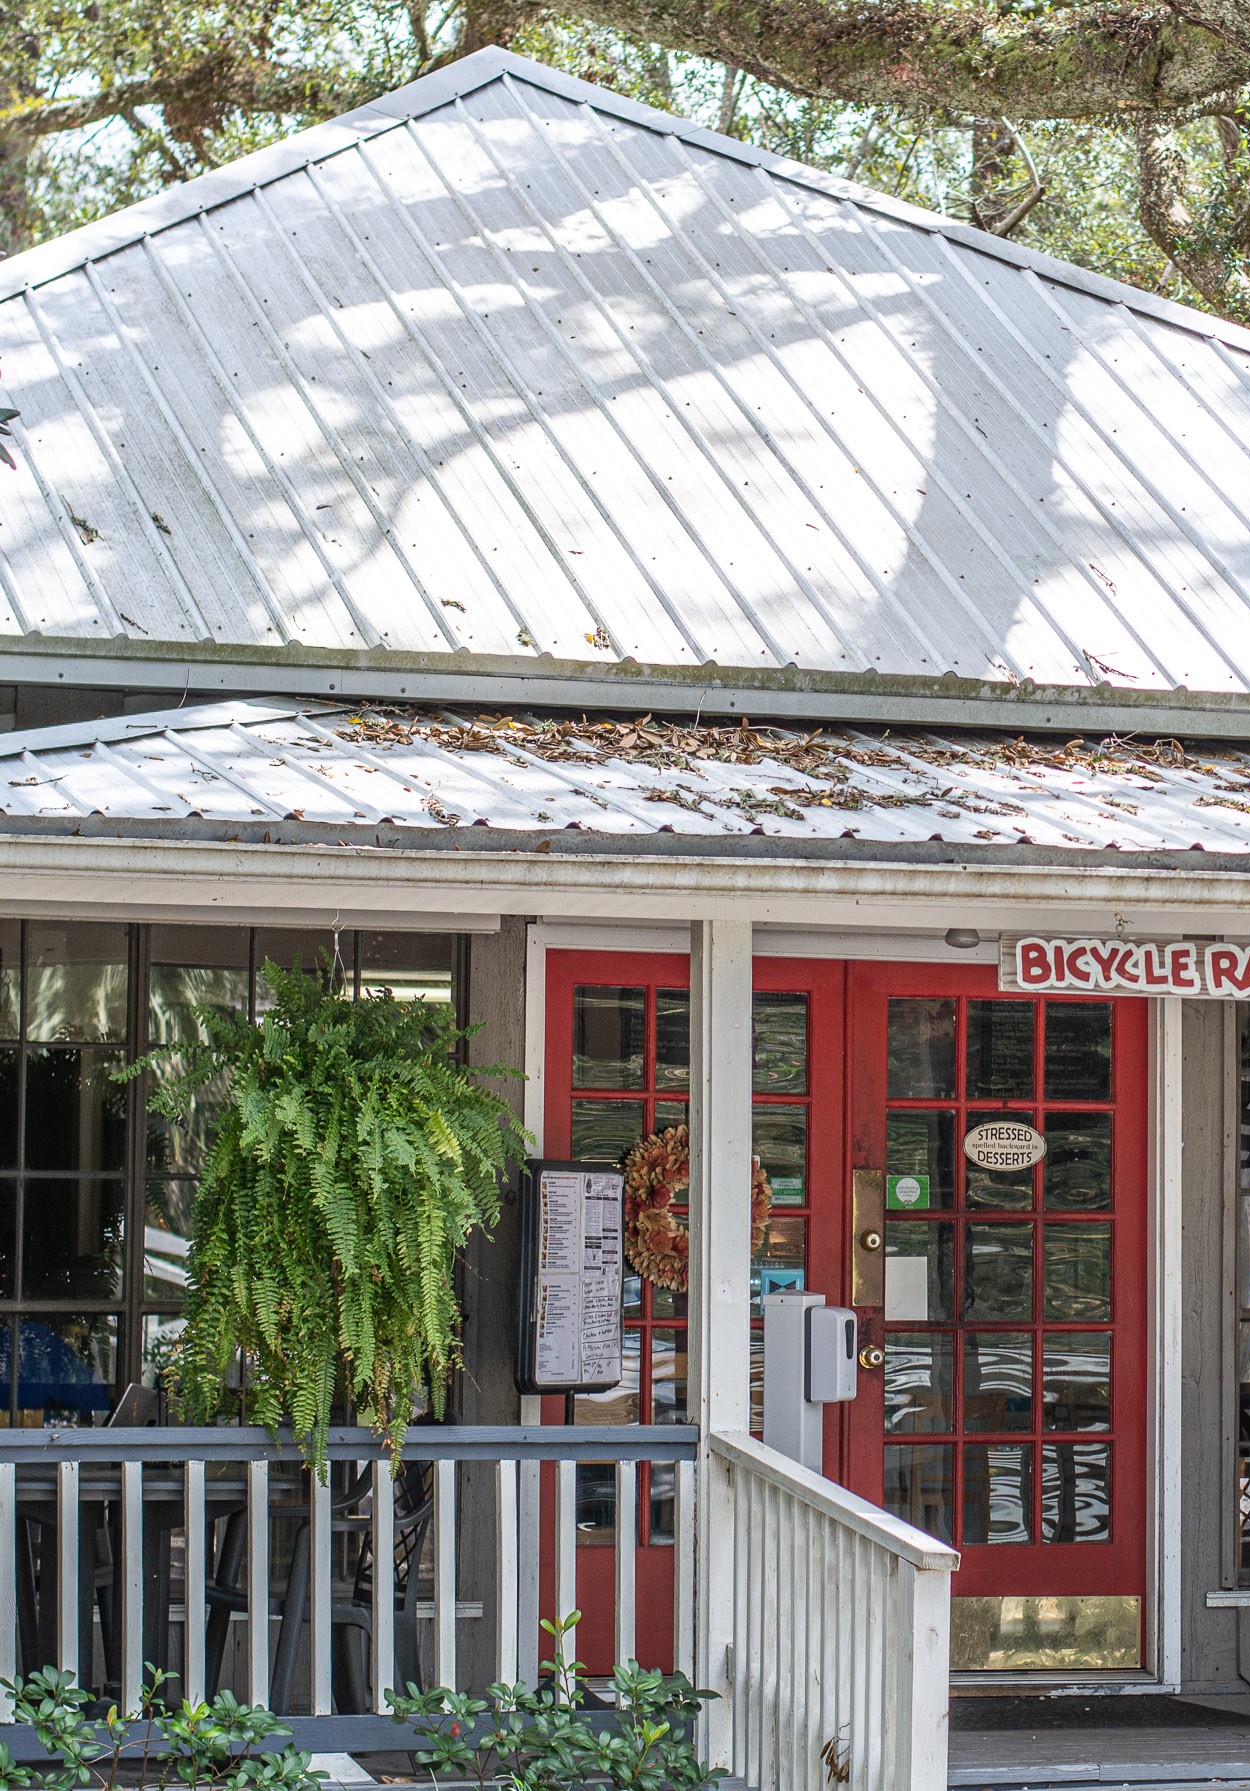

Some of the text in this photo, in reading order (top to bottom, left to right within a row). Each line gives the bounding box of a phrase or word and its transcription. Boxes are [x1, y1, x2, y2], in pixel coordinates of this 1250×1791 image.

[1020, 943, 1195, 988] BICYCLE
[978, 1127, 1032, 1142] STRESSED
[971, 1142, 996, 1150] spelled
[997, 1142, 1030, 1150] backward
[977, 1151, 1032, 1165] DESSERTS
